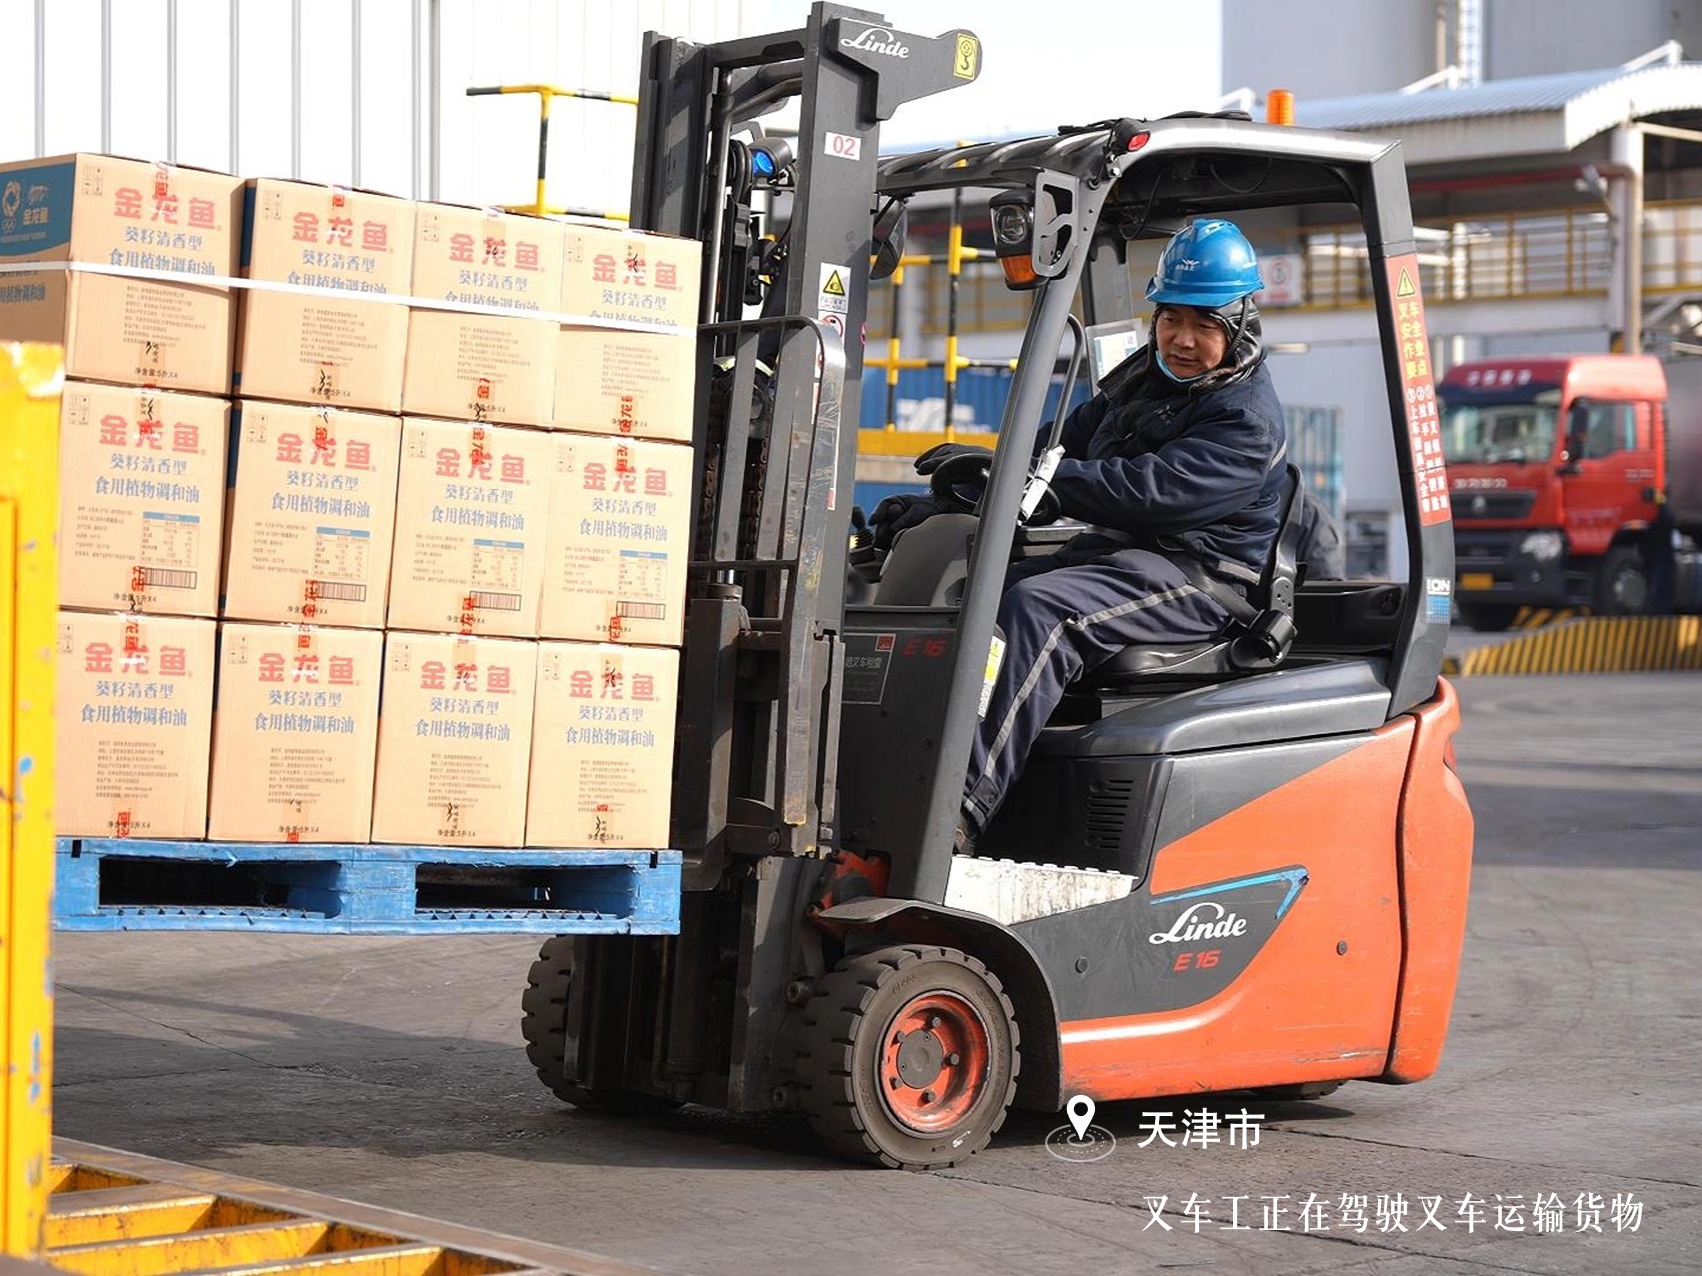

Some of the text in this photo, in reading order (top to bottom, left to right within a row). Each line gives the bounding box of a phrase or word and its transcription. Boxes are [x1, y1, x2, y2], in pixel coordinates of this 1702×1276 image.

[840, 27, 909, 59] Linde
[833, 136, 856, 157] 02
[114, 187, 215, 229] 金龙鱼
[292, 212, 388, 251] 金龙鱼
[450, 234, 537, 270] 金龙鱼
[593, 255, 675, 289] 金龙鱼
[1398, 301, 1419, 320] 叉车
[1400, 321, 1422, 339] 安全
[100, 416, 198, 453] 金龙鱼
[276, 434, 369, 470] 金龙鱼
[435, 449, 524, 483] 金龙鱼
[96, 477, 199, 502] 食用植物调和油
[583, 463, 665, 495] 金龙鱼
[272, 494, 370, 518] 食用植物调和油
[432, 506, 524, 531] 食用植物调和油
[581, 519, 667, 539] 食用植物调和油
[85, 643, 184, 676] 金龙鱼
[259, 654, 351, 684] 金龙鱼
[421, 662, 509, 693] 金龙鱼
[570, 671, 652, 700] 金龙鱼
[82, 704, 187, 726] 食用植物调和油
[256, 713, 354, 733] 食用植物调和油
[417, 719, 510, 741] 食用植物调和油
[567, 728, 654, 747] 食用植物调和油
[1149, 902, 1247, 945] Linde
